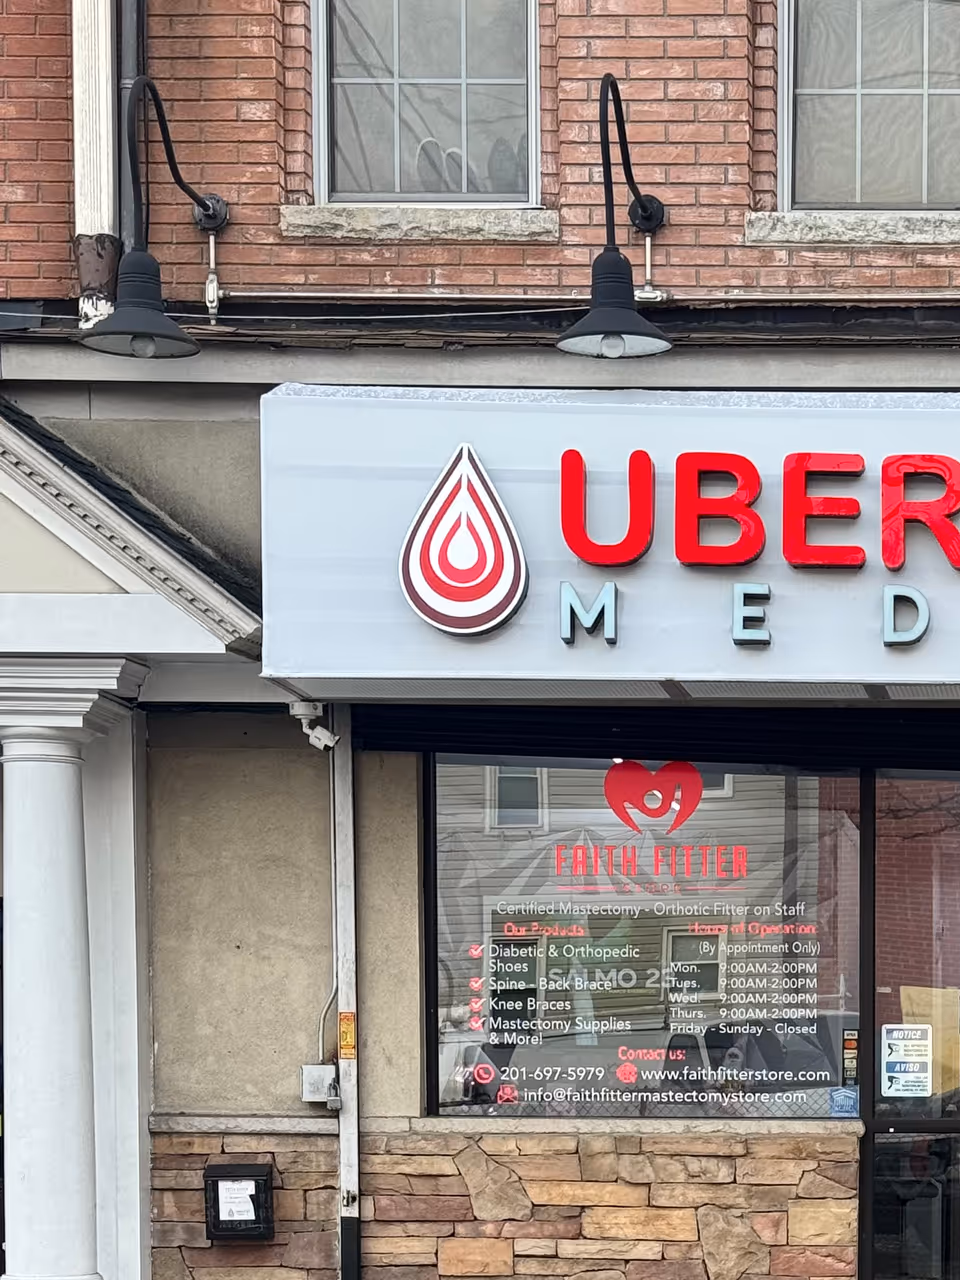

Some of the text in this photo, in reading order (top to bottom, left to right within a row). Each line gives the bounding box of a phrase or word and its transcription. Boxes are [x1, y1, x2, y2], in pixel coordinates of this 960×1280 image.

[556, 845, 748, 877] FAITH FITTER
[497, 901, 554, 915] Certified
[559, 902, 641, 918] Mastectomy
[653, 902, 709, 915] Orthotic
[714, 902, 749, 915] Fitter
[753, 906, 770, 915] on
[775, 901, 806, 915] Staff
[504, 921, 584, 936] Our Products
[689, 922, 727, 935] Hours
[731, 921, 744, 935] of
[489, 944, 640, 961] Diabetic & Orthopedic
[699, 942, 820, 955] (By Appointment Only)
[489, 959, 528, 972] Shoes
[670, 963, 818, 973] Mon. 9:00AM-2:00PM
[489, 978, 525, 994] Spine
[539, 978, 569, 990] Back
[575, 978, 612, 990] Brace
[670, 978, 818, 988] Tues. 9:00AM-2:00PM
[489, 999, 571, 1010] Knee Braces
[670, 993, 818, 1003] Wed. 9:00AM-2:00PM
[670, 1008, 818, 1018] Thurs. 9:00AM-2:00PM
[489, 1017, 631, 1034] Mastectomy Supplies
[670, 1023, 708, 1036] Friday
[719, 1023, 763, 1036] Sunday
[775, 1023, 817, 1034] Closed
[489, 1033, 543, 1045] & More!
[892, 1030, 921, 1039] NOTICE
[618, 1046, 686, 1061] Contact us:
[500, 1066, 830, 1081] 201-697-5979 www.faithfitterstore.com
[894, 1063, 919, 1072] AVISO
[524, 1088, 807, 1104] info@faithfittermastectomystore.com
